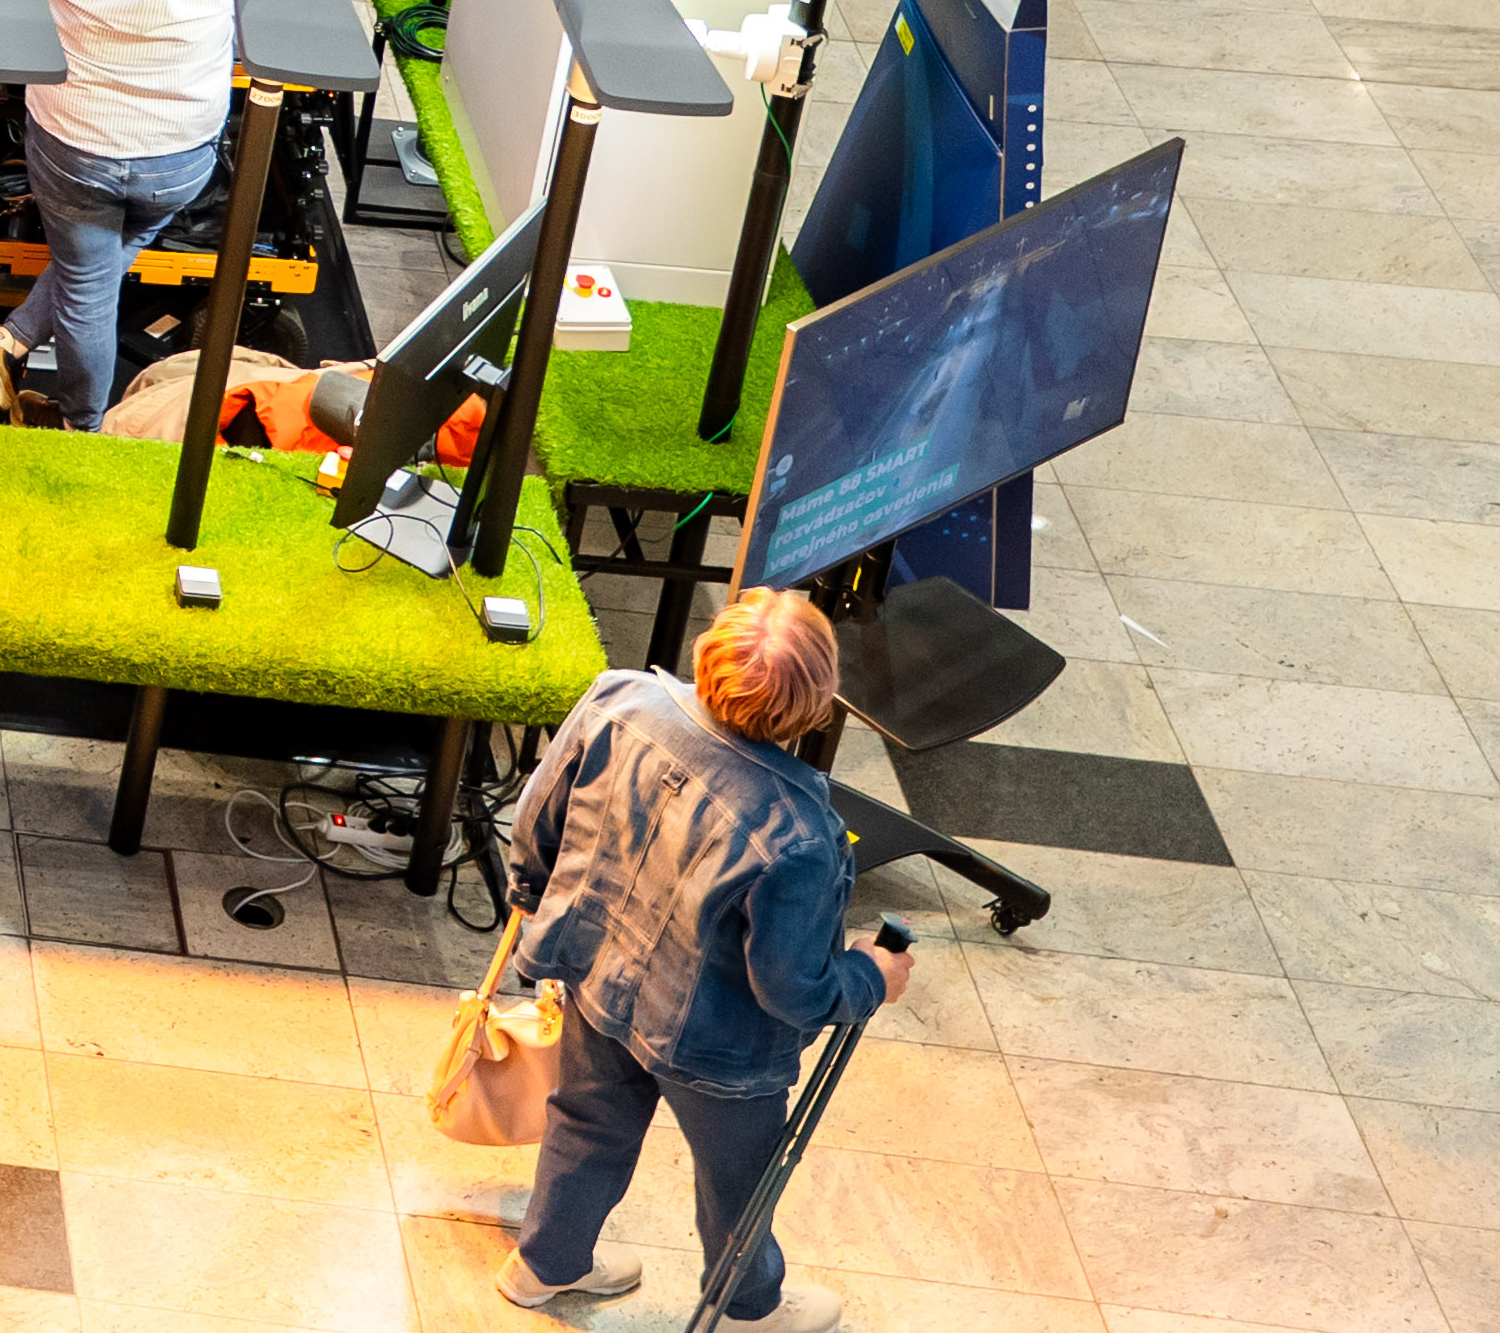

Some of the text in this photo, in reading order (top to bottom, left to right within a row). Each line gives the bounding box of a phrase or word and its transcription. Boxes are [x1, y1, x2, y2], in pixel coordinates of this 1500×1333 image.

[770, 472, 954, 571] verejného osvetlenia
[775, 484, 887, 549] rozvádzačov
[781, 488, 834, 524] Máme
[865, 440, 929, 483] SMART
